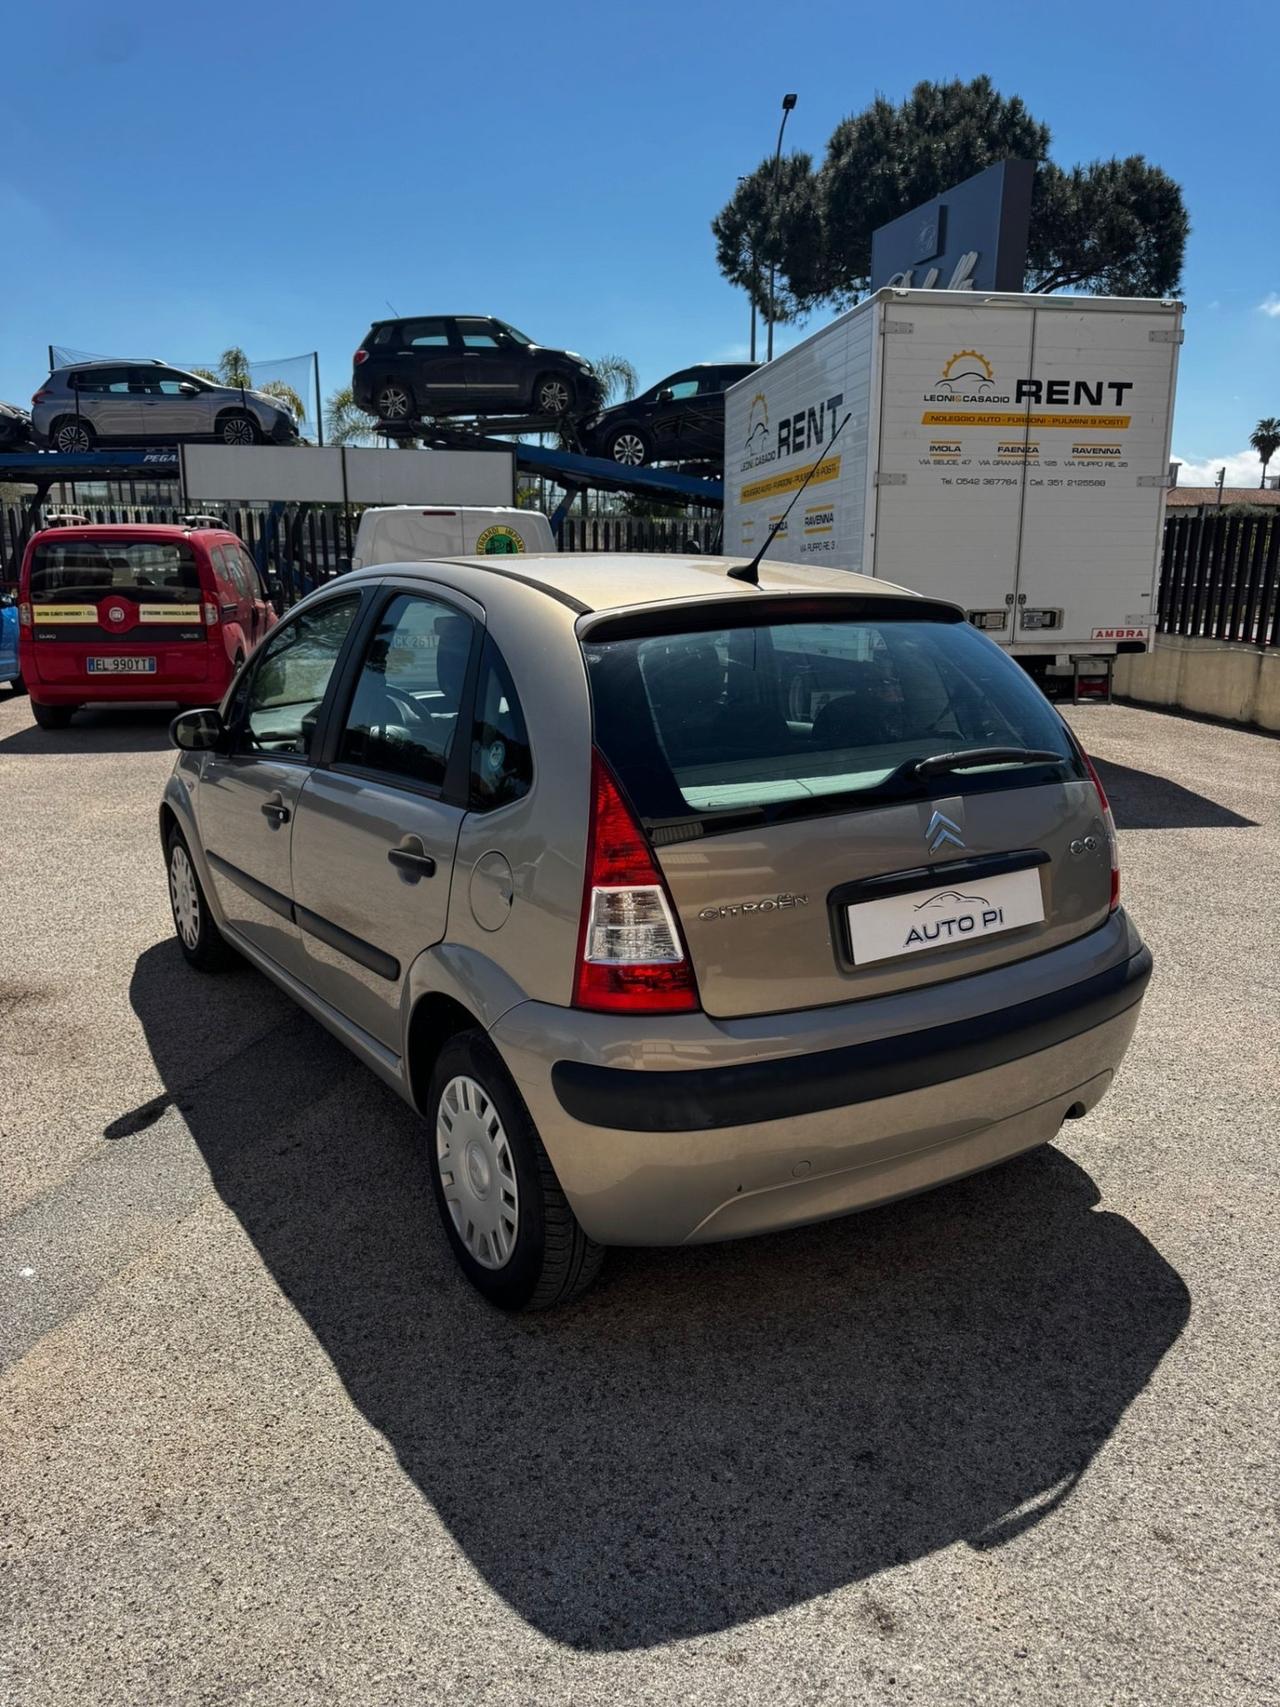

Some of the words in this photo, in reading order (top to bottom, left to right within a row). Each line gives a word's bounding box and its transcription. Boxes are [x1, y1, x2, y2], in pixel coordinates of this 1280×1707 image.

[1015, 379, 1133, 407] RENT
[930, 415, 976, 423] NOLEGGIO
[777, 392, 844, 459] RENT
[929, 445, 962, 453] IMOLA
[997, 446, 1039, 454] FAENZA
[1072, 447, 1121, 455] RAVENNA
[956, 478, 980, 486] 0542
[804, 512, 834, 527] RAVENNA
[1096, 630, 1144, 638] AMBRA
[96, 658, 109, 670] EL
[112, 658, 146, 670] 990YT
[698, 892, 809, 922] CITROËN
[902, 914, 976, 948] AUTO
[982, 908, 1004, 929] PI
